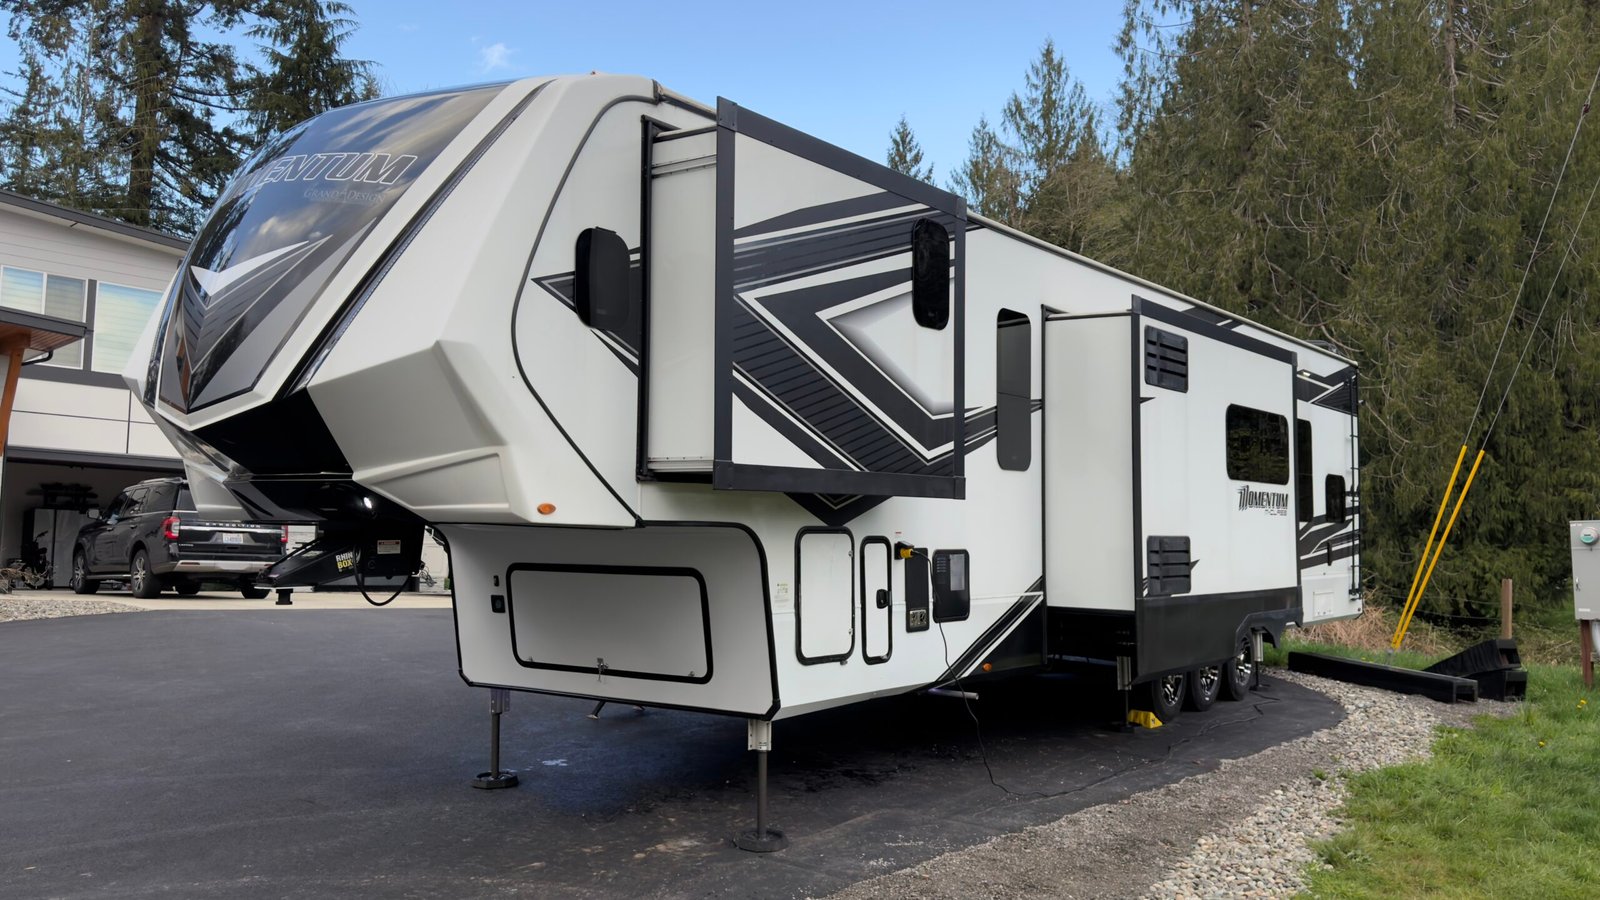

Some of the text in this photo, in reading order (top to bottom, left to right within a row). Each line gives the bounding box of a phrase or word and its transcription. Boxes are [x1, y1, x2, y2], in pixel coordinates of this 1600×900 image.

[303, 187, 386, 202] GRAND DESIGN
[1237, 485, 1288, 511] MOMENTUM
[337, 559, 353, 569] BOX
